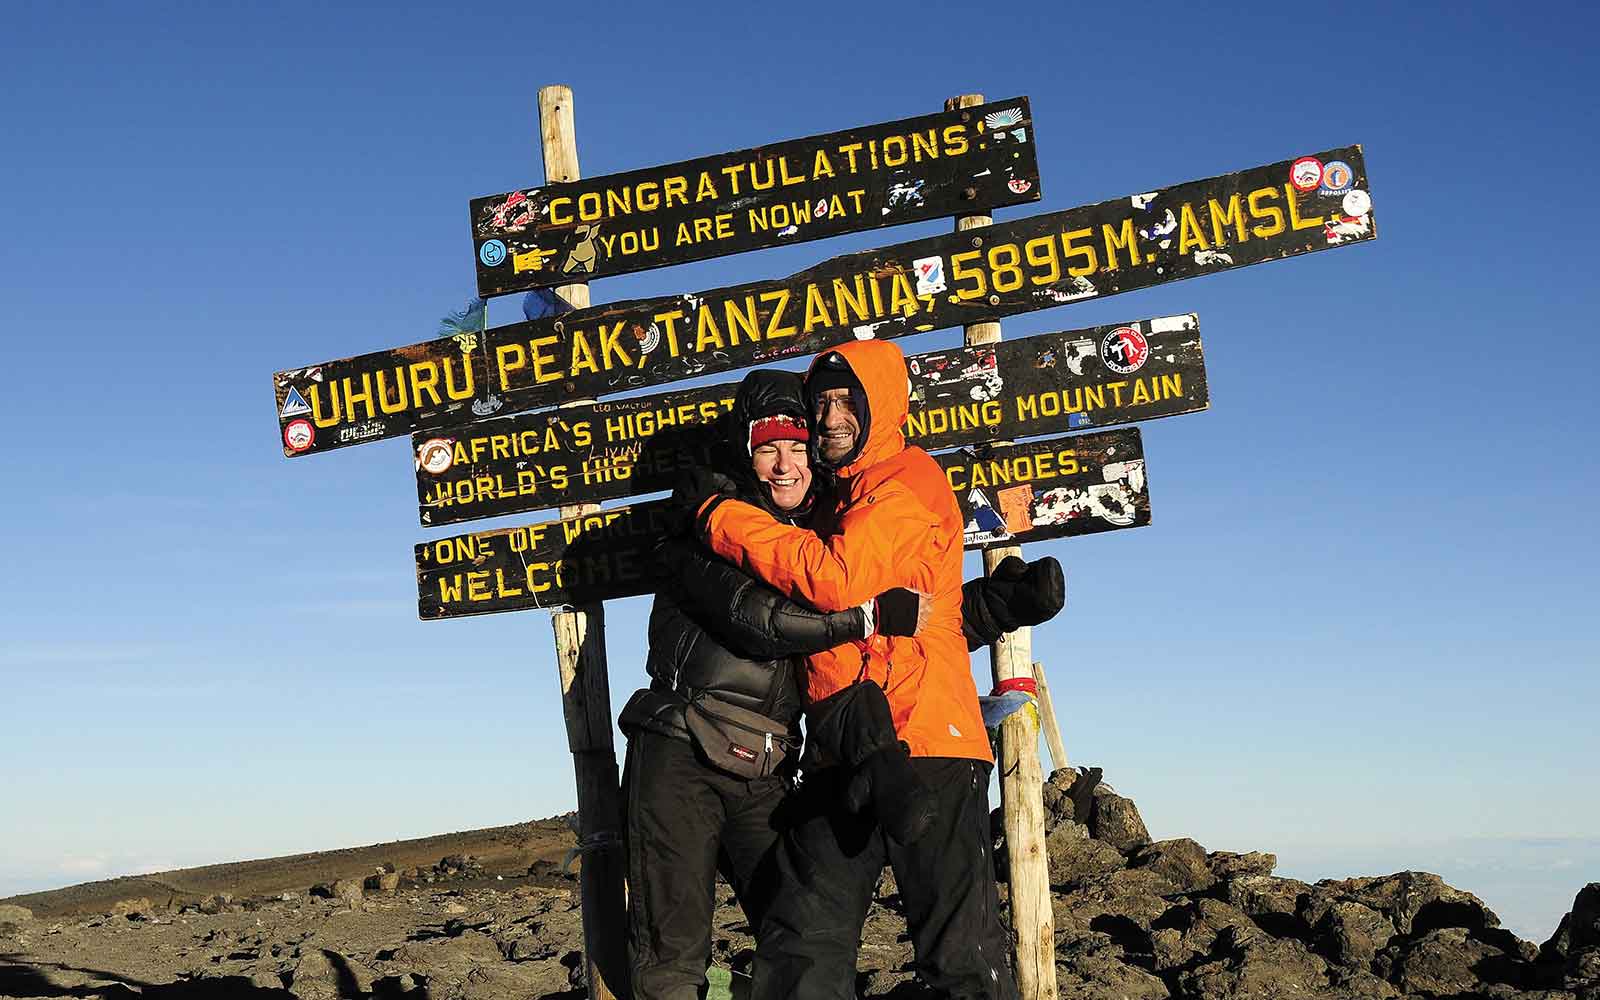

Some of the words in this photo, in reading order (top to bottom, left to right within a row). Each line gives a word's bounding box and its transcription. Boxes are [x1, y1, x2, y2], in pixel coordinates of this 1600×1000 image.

[549, 120, 986, 226] CONGRATULATIONS!
[599, 227, 660, 258] YOU
[675, 213, 735, 247] ARE
[748, 199, 811, 233] NOW
[828, 189, 866, 220] AT
[309, 350, 476, 429] UHURU
[495, 320, 648, 392] PEAK,
[654, 264, 936, 358] TANZANIA,
[1016, 372, 1184, 422] MOUNTAIN
[435, 534, 496, 565] ONE
[509, 524, 548, 553] OF
